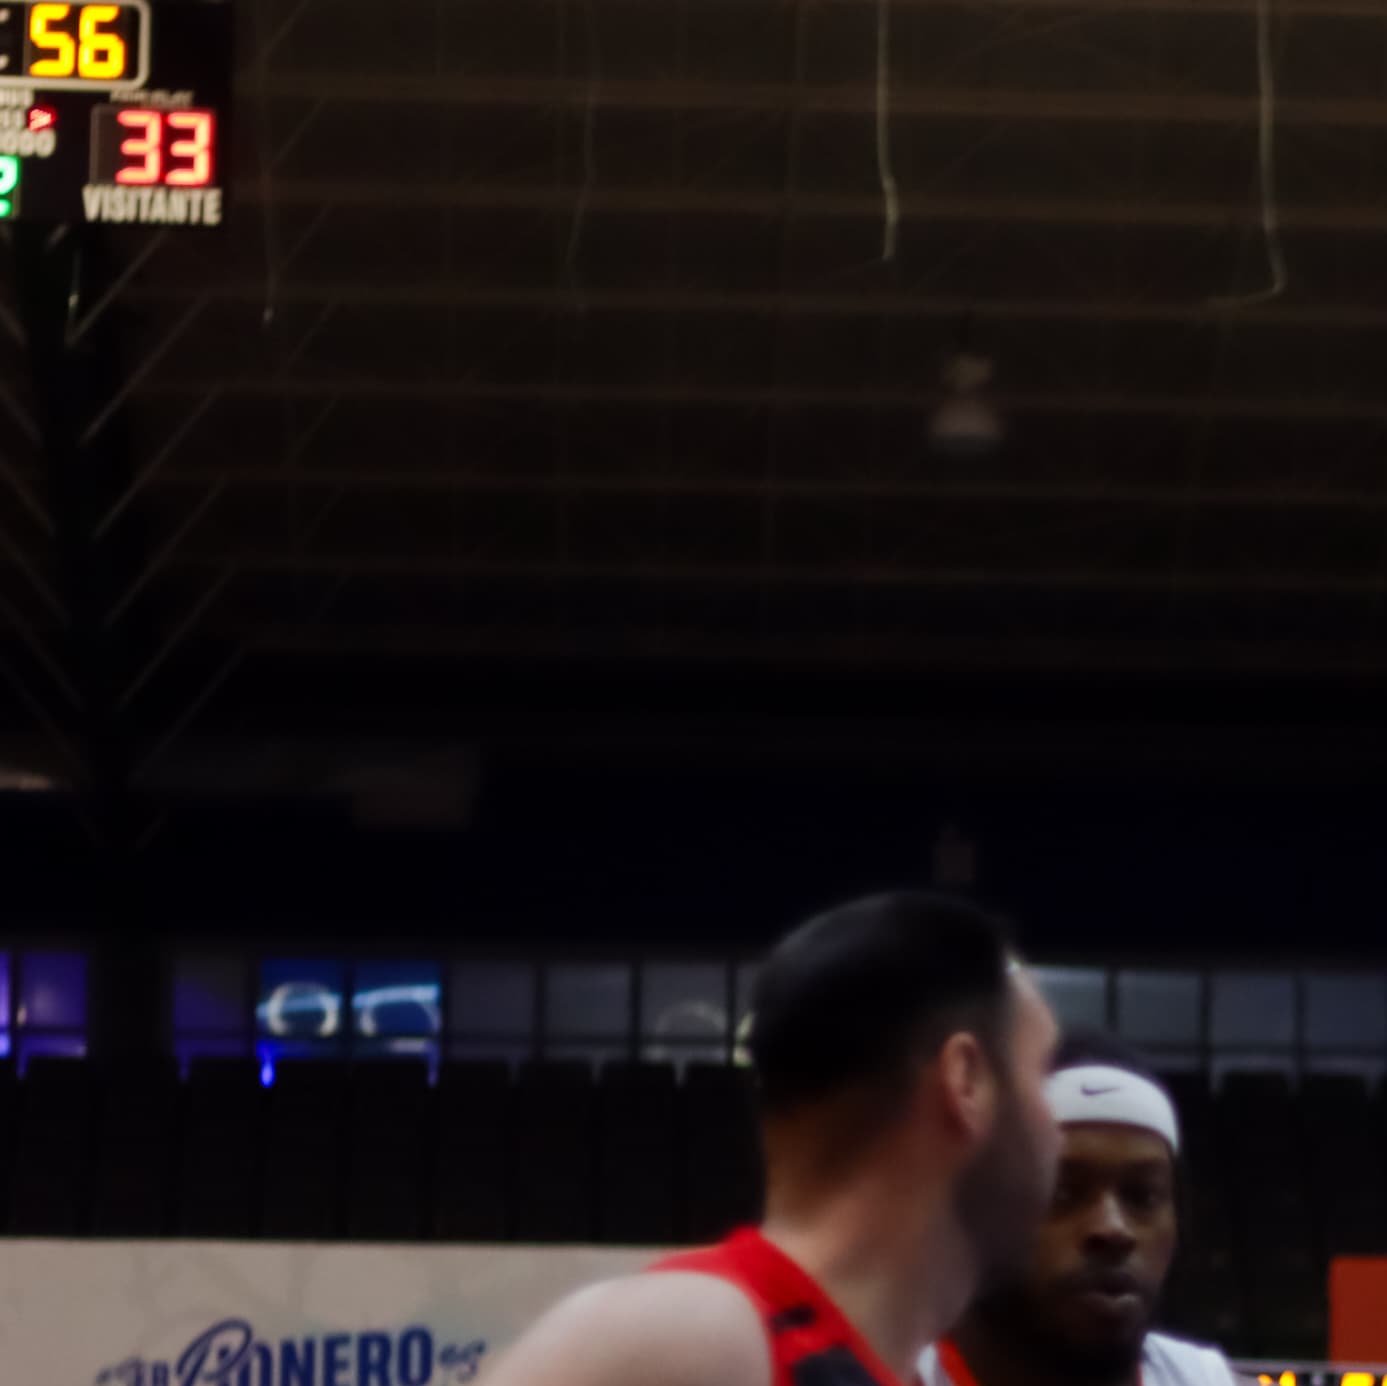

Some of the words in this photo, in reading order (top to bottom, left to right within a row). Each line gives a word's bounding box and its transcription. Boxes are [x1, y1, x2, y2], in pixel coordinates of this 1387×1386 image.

[29, 2, 125, 79] 56
[115, 109, 213, 186] 33
[82, 184, 223, 225] VISITANTE
